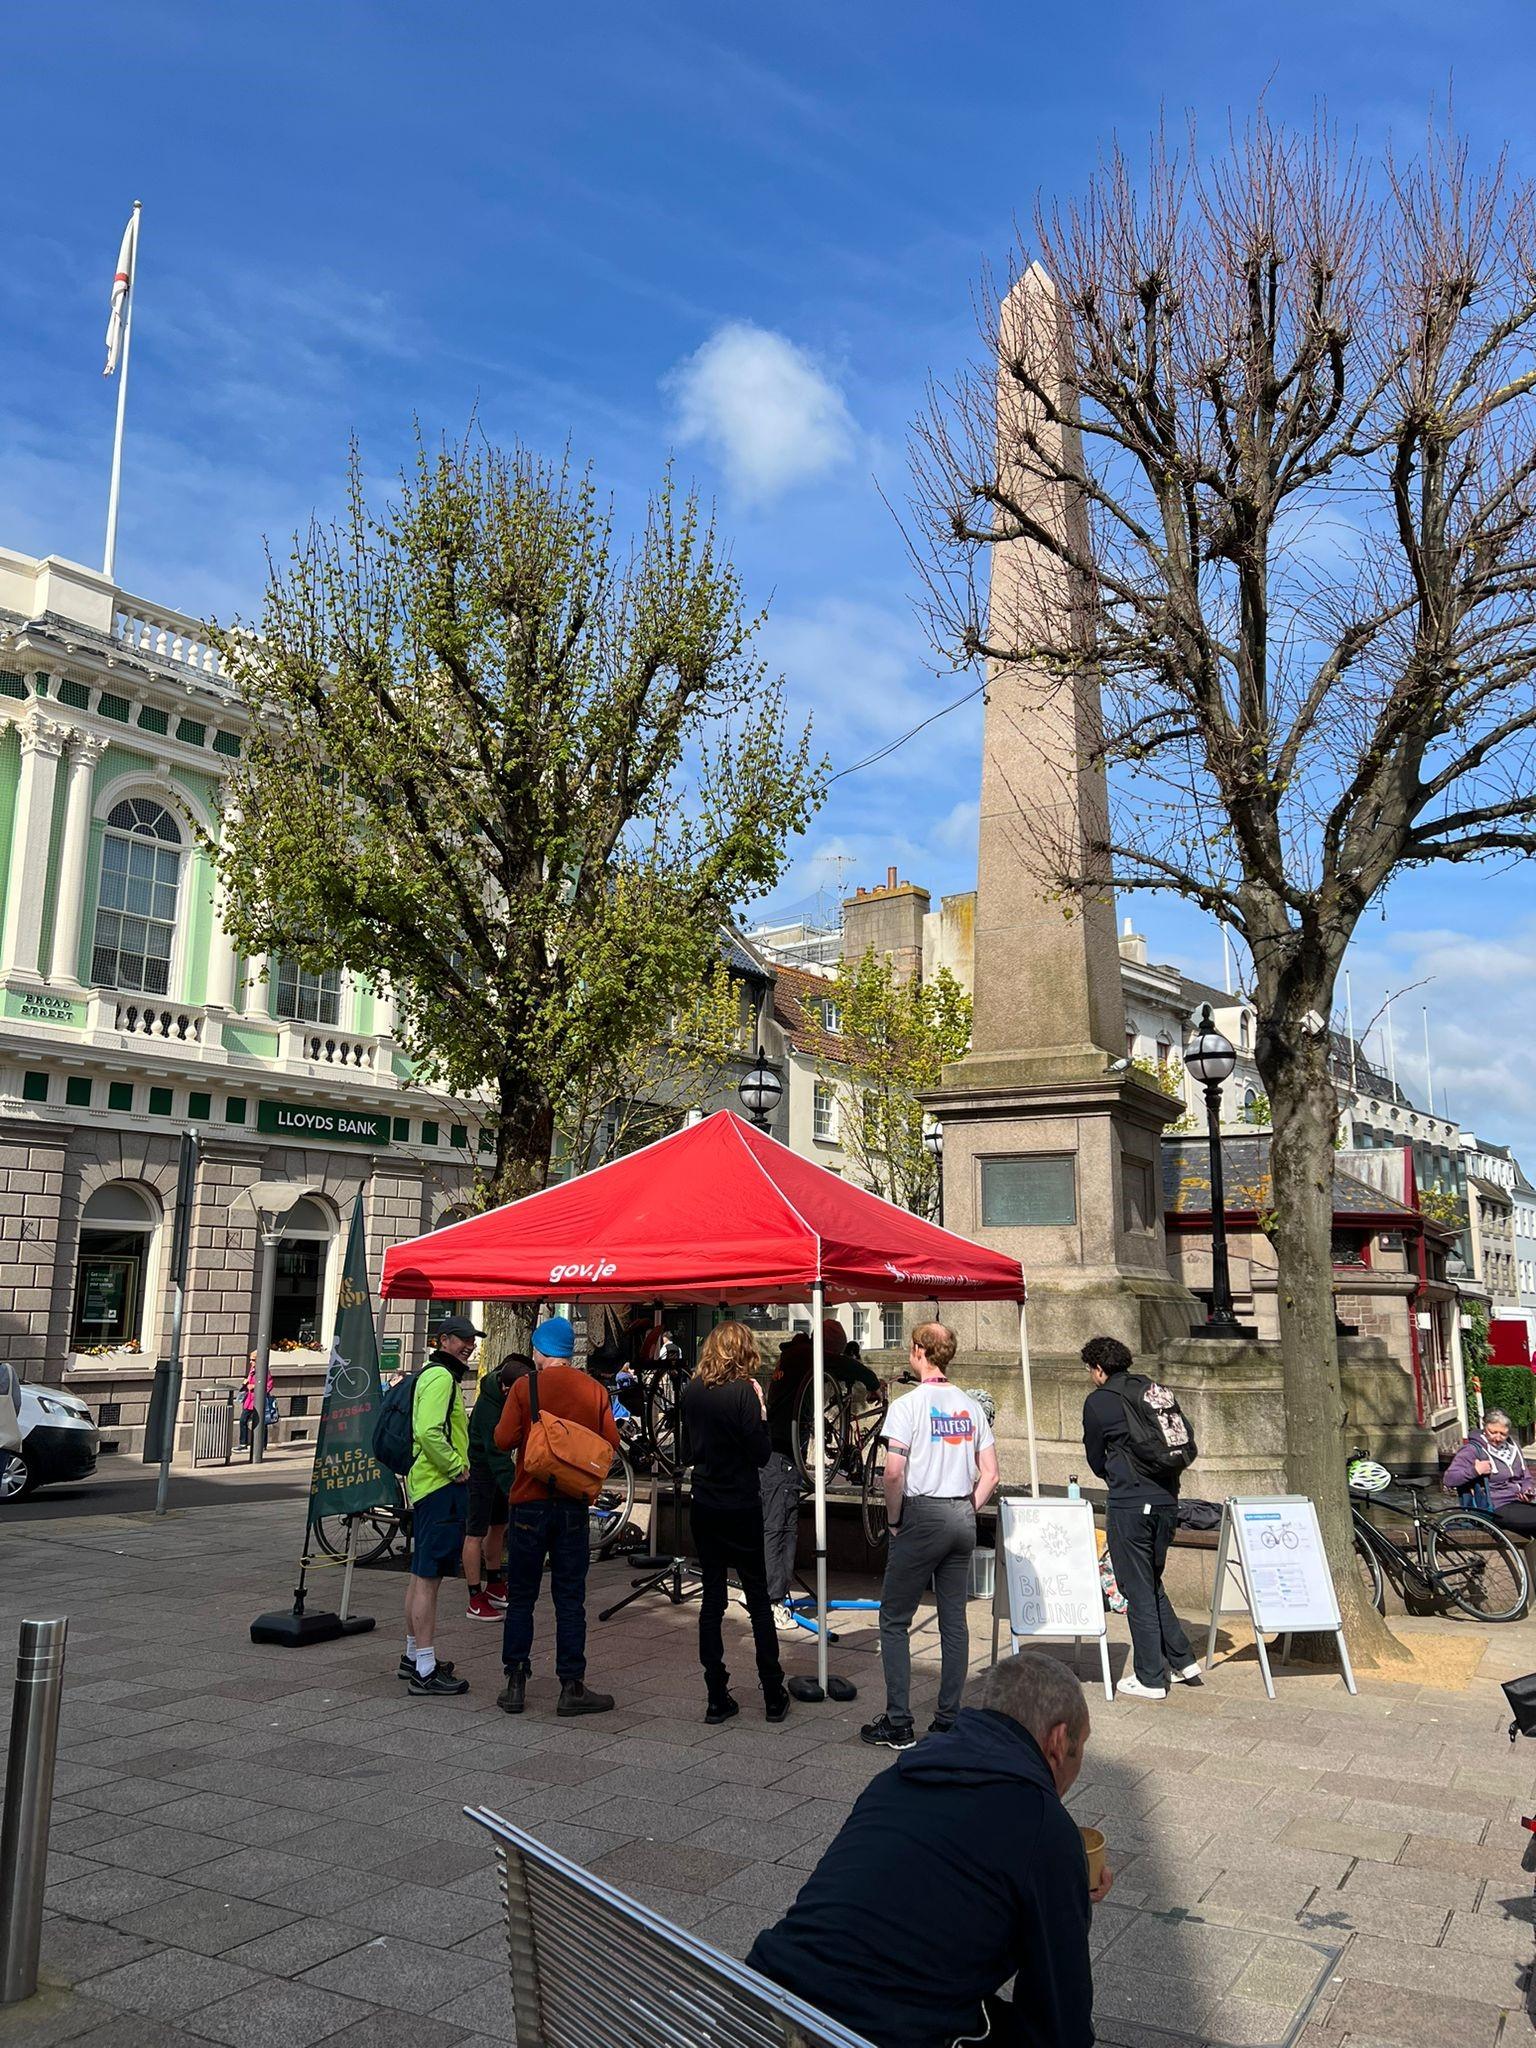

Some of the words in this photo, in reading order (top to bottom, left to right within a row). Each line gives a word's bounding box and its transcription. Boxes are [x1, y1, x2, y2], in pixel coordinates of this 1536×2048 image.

[21, 1005, 73, 1020] STREET
[25, 993, 71, 1008] BROAD
[278, 1110, 334, 1131] LLOYDS
[338, 1118, 377, 1136] BANK
[549, 1257, 617, 1283] gov.je
[312, 1457, 376, 1482] SERVICE
[315, 1448, 368, 1469] SALES,
[326, 1468, 382, 1491] REPAIR
[1018, 1574, 1072, 1598] BIKE
[1022, 1601, 1090, 1626] CLINIC
